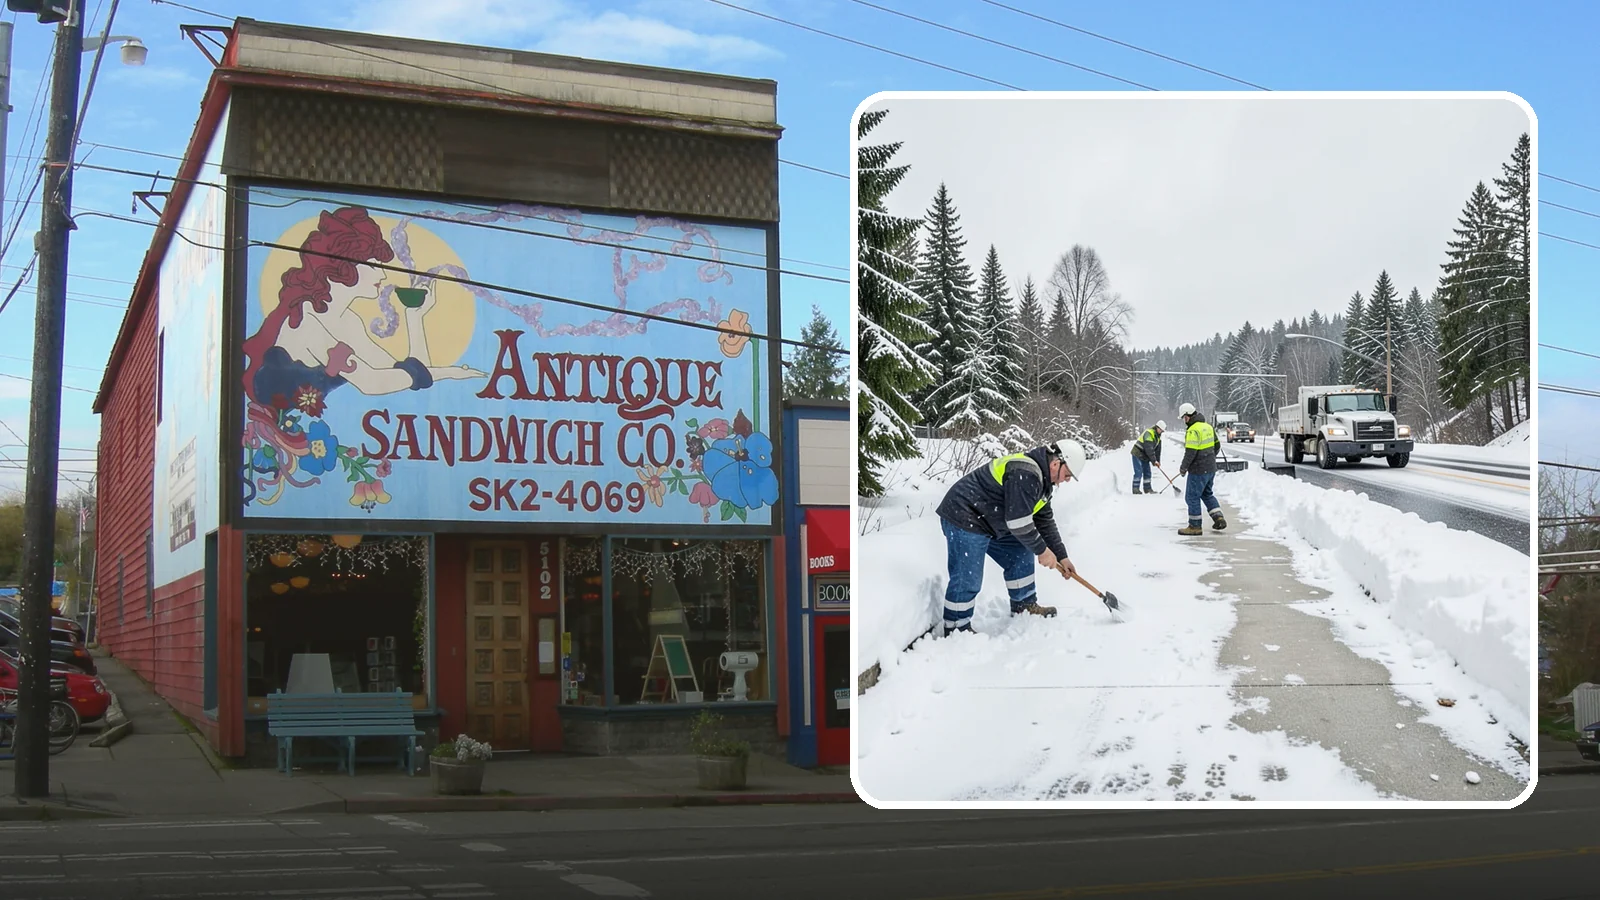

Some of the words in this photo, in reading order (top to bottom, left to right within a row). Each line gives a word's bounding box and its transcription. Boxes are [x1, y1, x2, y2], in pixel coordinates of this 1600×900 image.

[476, 329, 723, 420] ANTIQUE
[361, 408, 604, 467] SANDWICH
[616, 421, 685, 468] CO.
[468, 477, 645, 513] SK2-4069
[540, 541, 551, 600] 5102
[809, 555, 835, 569] BOOKS
